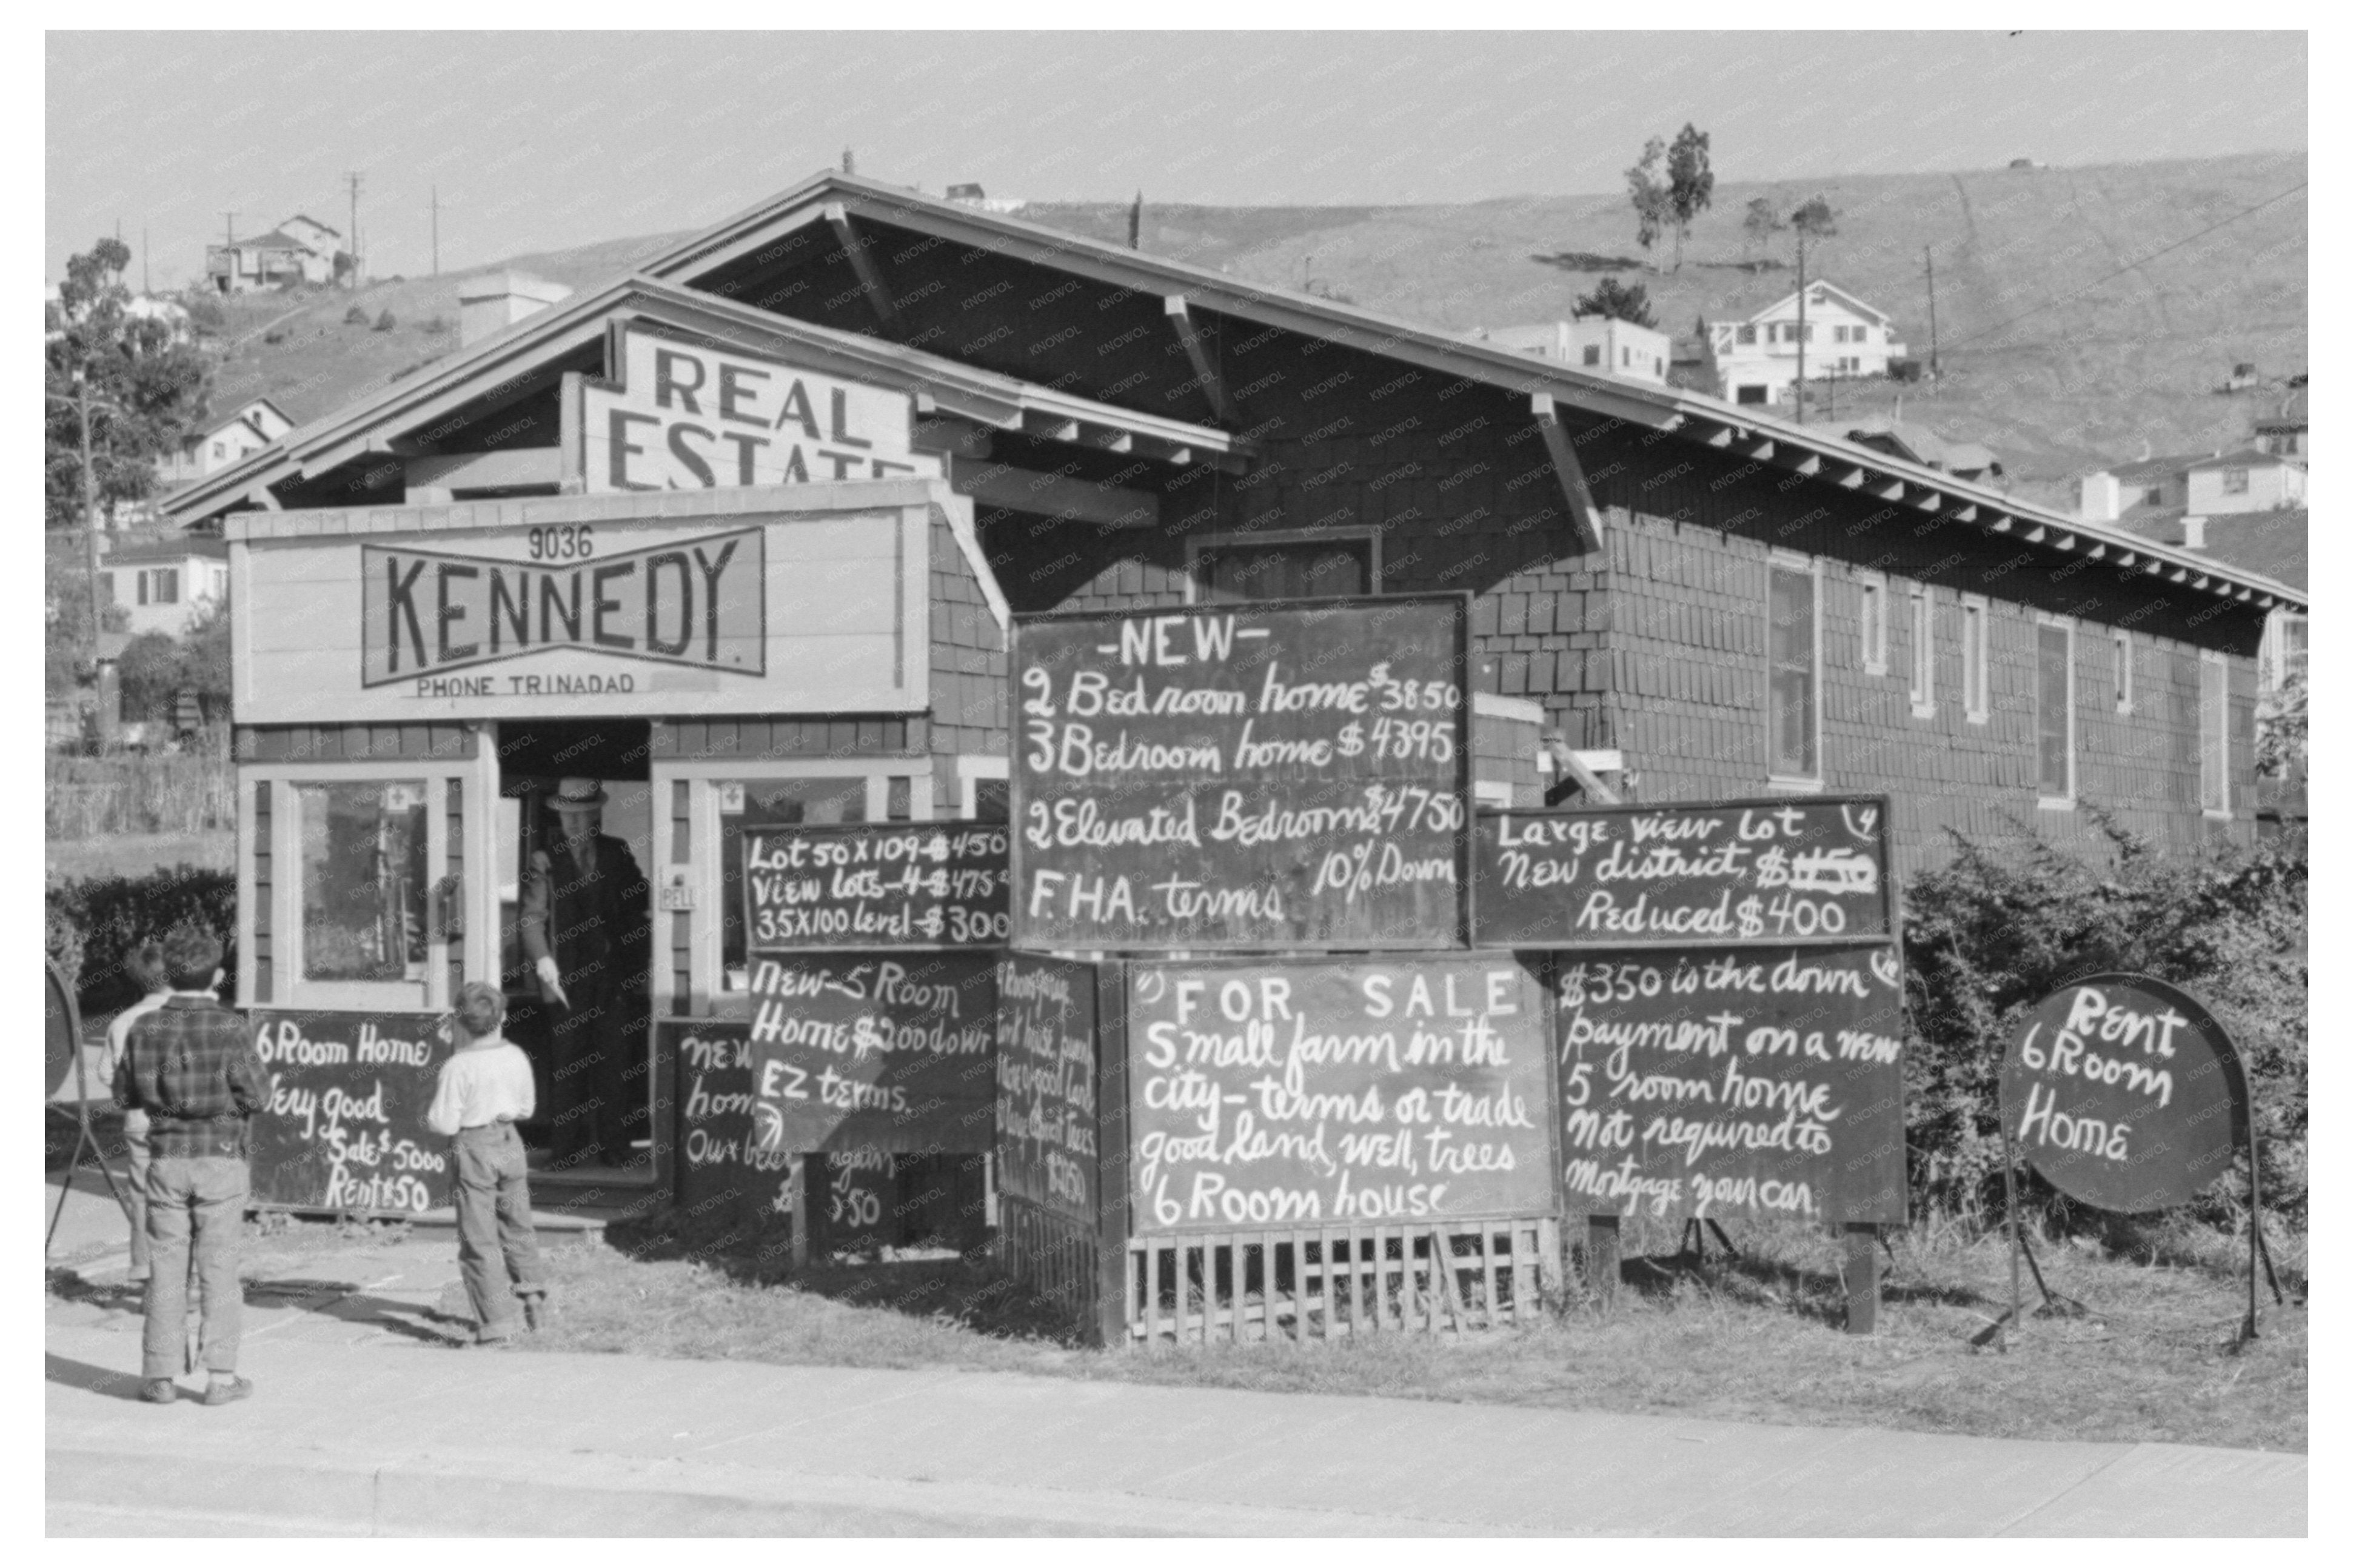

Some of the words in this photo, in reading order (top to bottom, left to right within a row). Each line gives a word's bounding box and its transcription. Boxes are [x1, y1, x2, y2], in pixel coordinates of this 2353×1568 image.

[655, 347, 872, 449] REAL
[609, 408, 916, 491] EST
[529, 525, 593, 559] 9036
[417, 676, 495, 698] PHONE
[509, 673, 634, 695] TRINADAD
[1023, 667, 1056, 716] 2
[1260, 661, 1370, 713] home
[1027, 719, 1056, 773] 3
[1060, 722, 1221, 776] Bedroom
[1235, 718, 1331, 770] home
[1026, 802, 1052, 850] 2
[1055, 795, 1201, 847] Elevated
[1498, 815, 1609, 855] Large
[1632, 811, 1723, 842] view
[749, 836, 810, 870] Lot
[1314, 840, 1375, 902] 10%
[1376, 842, 1456, 887] Down
[1498, 850, 1579, 889] New
[663, 887, 696, 909] BELL
[752, 872, 821, 906] View
[1577, 889, 1736, 932] Reduced
[874, 961, 960, 1018] Room
[1176, 977, 1292, 1026] FOR
[1362, 971, 1517, 1019] SALE
[1560, 962, 1662, 1010] $350
[1670, 956, 1699, 994] is
[1702, 955, 1766, 993] the
[1771, 949, 1870, 997] down
[256, 1022, 273, 1063] 6
[275, 1020, 349, 1066] Room
[356, 1022, 432, 1067] Home
[751, 999, 849, 1053] Home
[1561, 1007, 1743, 1081] payment
[1746, 1026, 1798, 1055] on
[1804, 1032, 1832, 1061] a
[1837, 1030, 1901, 1064] new
[2066, 986, 2189, 1058] Rent
[760, 1058, 809, 1099] EZ
[1145, 1018, 1283, 1068] Small
[1285, 1012, 1403, 1096] farm
[1404, 1020, 1453, 1064] in
[1455, 1013, 1510, 1066] the
[2023, 1021, 2046, 1070] 6
[2047, 1029, 2174, 1109] Room
[317, 1078, 390, 1139] good
[685, 1075, 755, 1117] hom
[1395, 1088, 1431, 1124] or
[1432, 1082, 1535, 1129] trade
[1567, 1062, 1593, 1106] 5
[1610, 1072, 1716, 1103] room
[1721, 1055, 1844, 1121] home
[327, 1127, 381, 1166] Sale
[687, 1129, 737, 1163] Our
[1567, 1108, 1635, 1149] Not
[1794, 1118, 1832, 1155] to
[2019, 1081, 2133, 1161] Home
[324, 1163, 382, 1209] Rent
[1141, 1131, 1221, 1194] good
[1424, 1126, 1516, 1173] trees
[1565, 1154, 1684, 1217] Mortgage
[1154, 1175, 1182, 1226] 6
[1189, 1172, 1320, 1224] Room
[1333, 1169, 1449, 1218] house
